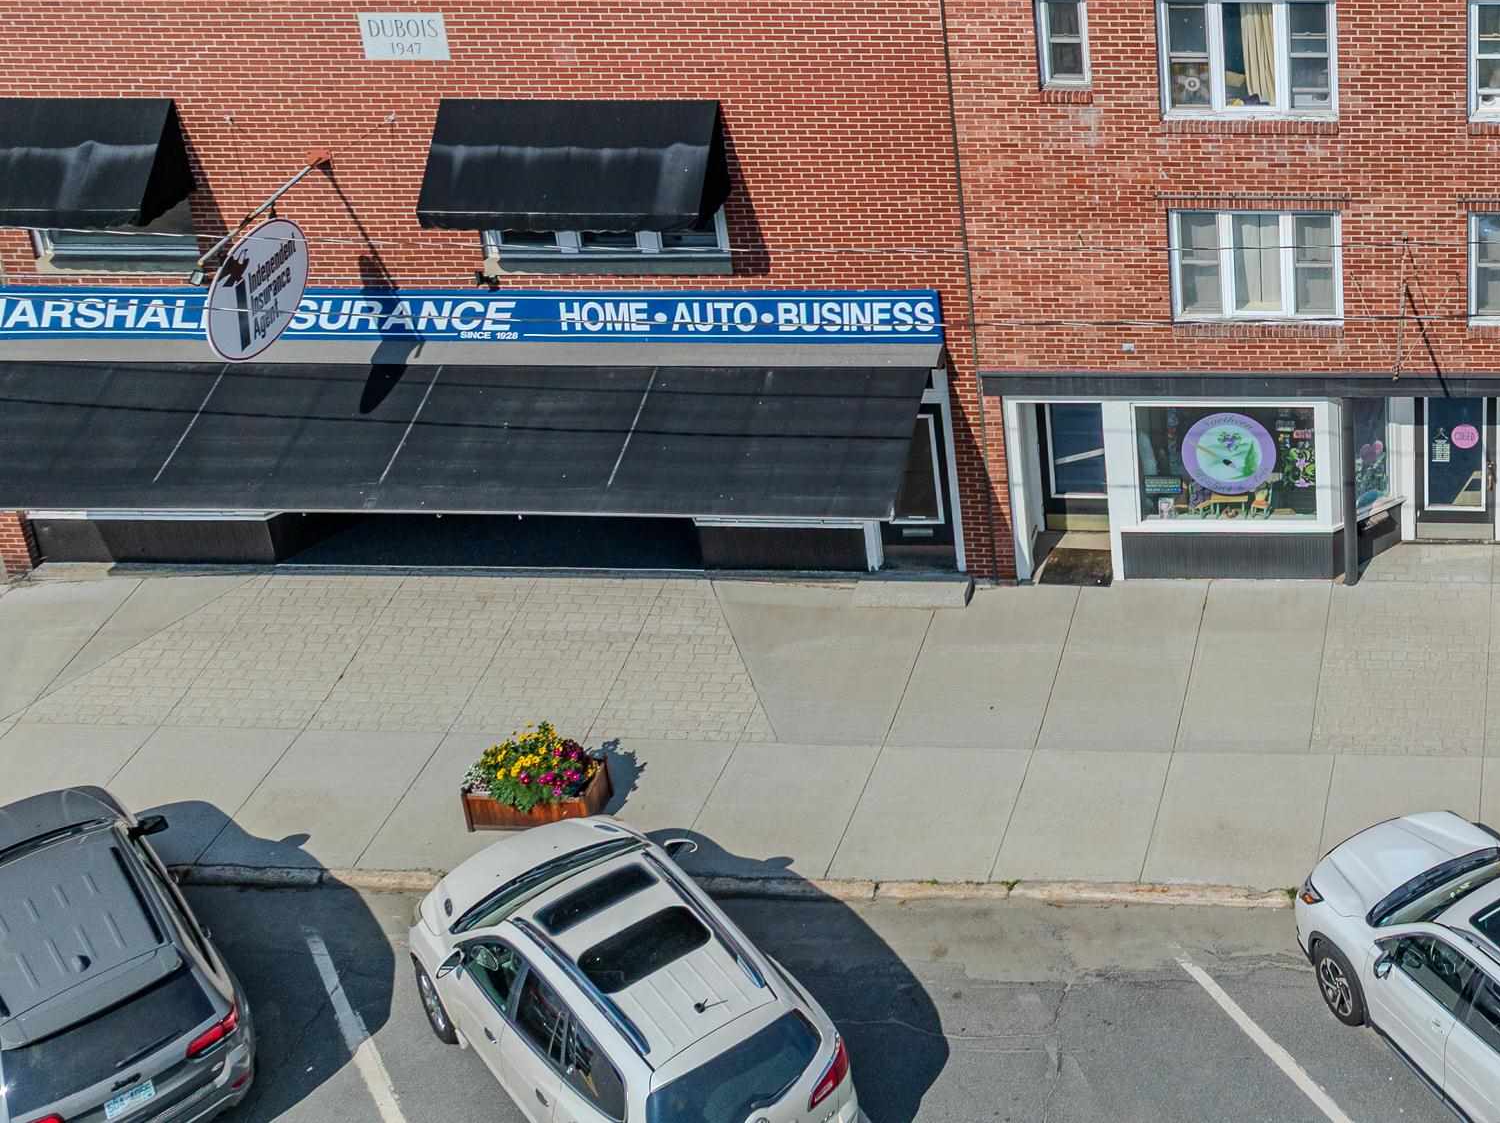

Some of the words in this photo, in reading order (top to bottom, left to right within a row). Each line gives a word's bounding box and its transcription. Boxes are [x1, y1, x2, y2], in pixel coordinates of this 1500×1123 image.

[367, 19, 438, 38] DUBOIS
[391, 42, 421, 55] 1947
[248, 232, 297, 293] Independent
[250, 266, 292, 315] Insurance
[0, 298, 210, 329] ARSHAL
[288, 299, 517, 331] SURANCE
[253, 298, 279, 340] Agent
[558, 301, 649, 332] HOME
[671, 302, 757, 332] AUTO
[777, 302, 935, 333] BUSINESS
[460, 330, 492, 340] SINCE
[496, 331, 519, 340] 1928
